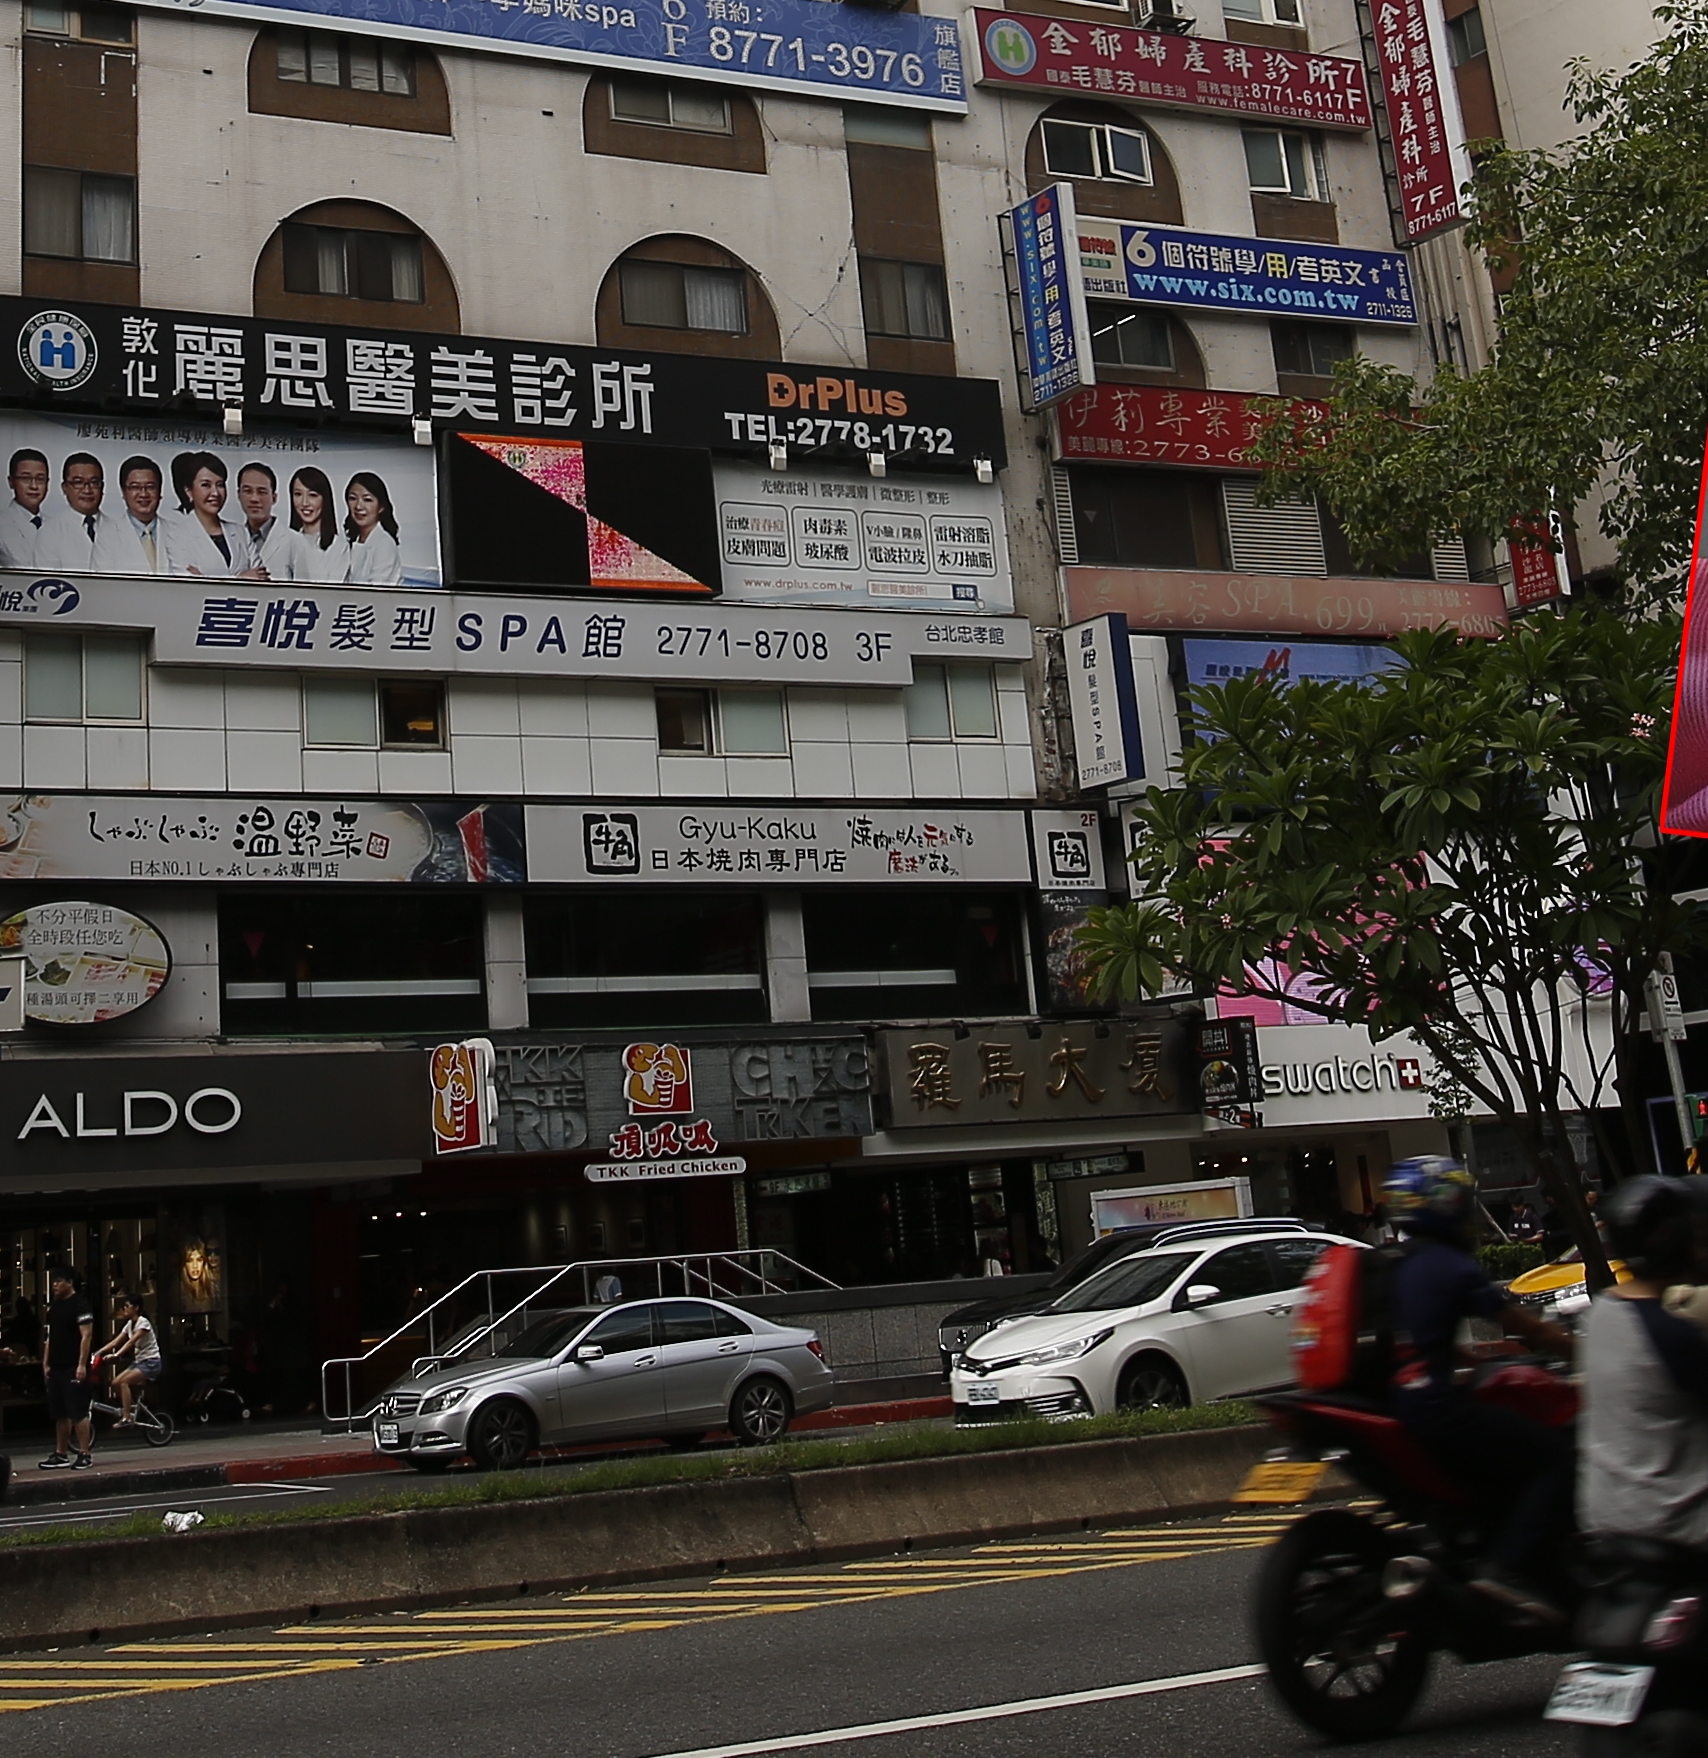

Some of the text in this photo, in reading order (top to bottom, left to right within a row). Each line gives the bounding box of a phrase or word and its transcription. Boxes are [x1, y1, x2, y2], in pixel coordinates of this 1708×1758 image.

[708, 26, 926, 87] 8771-3976
[933, 24, 962, 95] 旗艦店
[1040, 20, 1339, 92] 金郁婦產科診所
[1045, 64, 1188, 101] 國泰毛慧芬醫師主治
[1376, 0, 1430, 192] 金郁婦產科診所
[1196, 93, 1368, 127] www.femalecare.com.tw
[1408, 201, 1458, 237] 8771-6117
[1132, 273, 1360, 311] www.six.com.tw
[1366, 302, 1413, 319] 2711-1326
[121, 316, 159, 399] 敦化
[172, 323, 654, 435] 麗思醫美診所
[766, 372, 909, 417] DrPlus
[1034, 372, 1079, 402] 2711-1326
[724, 411, 954, 456] TEL:2778-1732
[927, 491, 950, 506] 整形
[804, 517, 848, 536] 肉毒素
[934, 525, 990, 544] 雷射溶脂
[727, 539, 786, 558] 皮膚問題
[805, 545, 849, 562] 玻尿酸
[868, 546, 926, 566] 電波拉皮
[937, 550, 992, 569] 水刀抽脂
[744, 578, 853, 591] www.drplus.com.tw
[657, 624, 830, 663] 2771-8708
[856, 632, 893, 664] 3F
[924, 622, 1006, 646] 台北忠孝館
[1080, 761, 1124, 781] 2771-8708
[88, 811, 222, 844] しゃぶしゃぶ
[678, 816, 817, 843] Gyu-Kaku
[1081, 813, 1096, 827] 2F
[591, 825, 634, 860] 牛角
[35, 908, 114, 926] 不分平假日
[26, 928, 124, 946] 全時段任您吃
[908, 1031, 1177, 1112] 羅馬大廈
[1260, 1051, 1398, 1096] swatch
[17, 1086, 243, 1140] ALDO
[610, 1118, 718, 1159] 頂呱呱
[597, 1160, 738, 1179] TKK Fried Chicken
